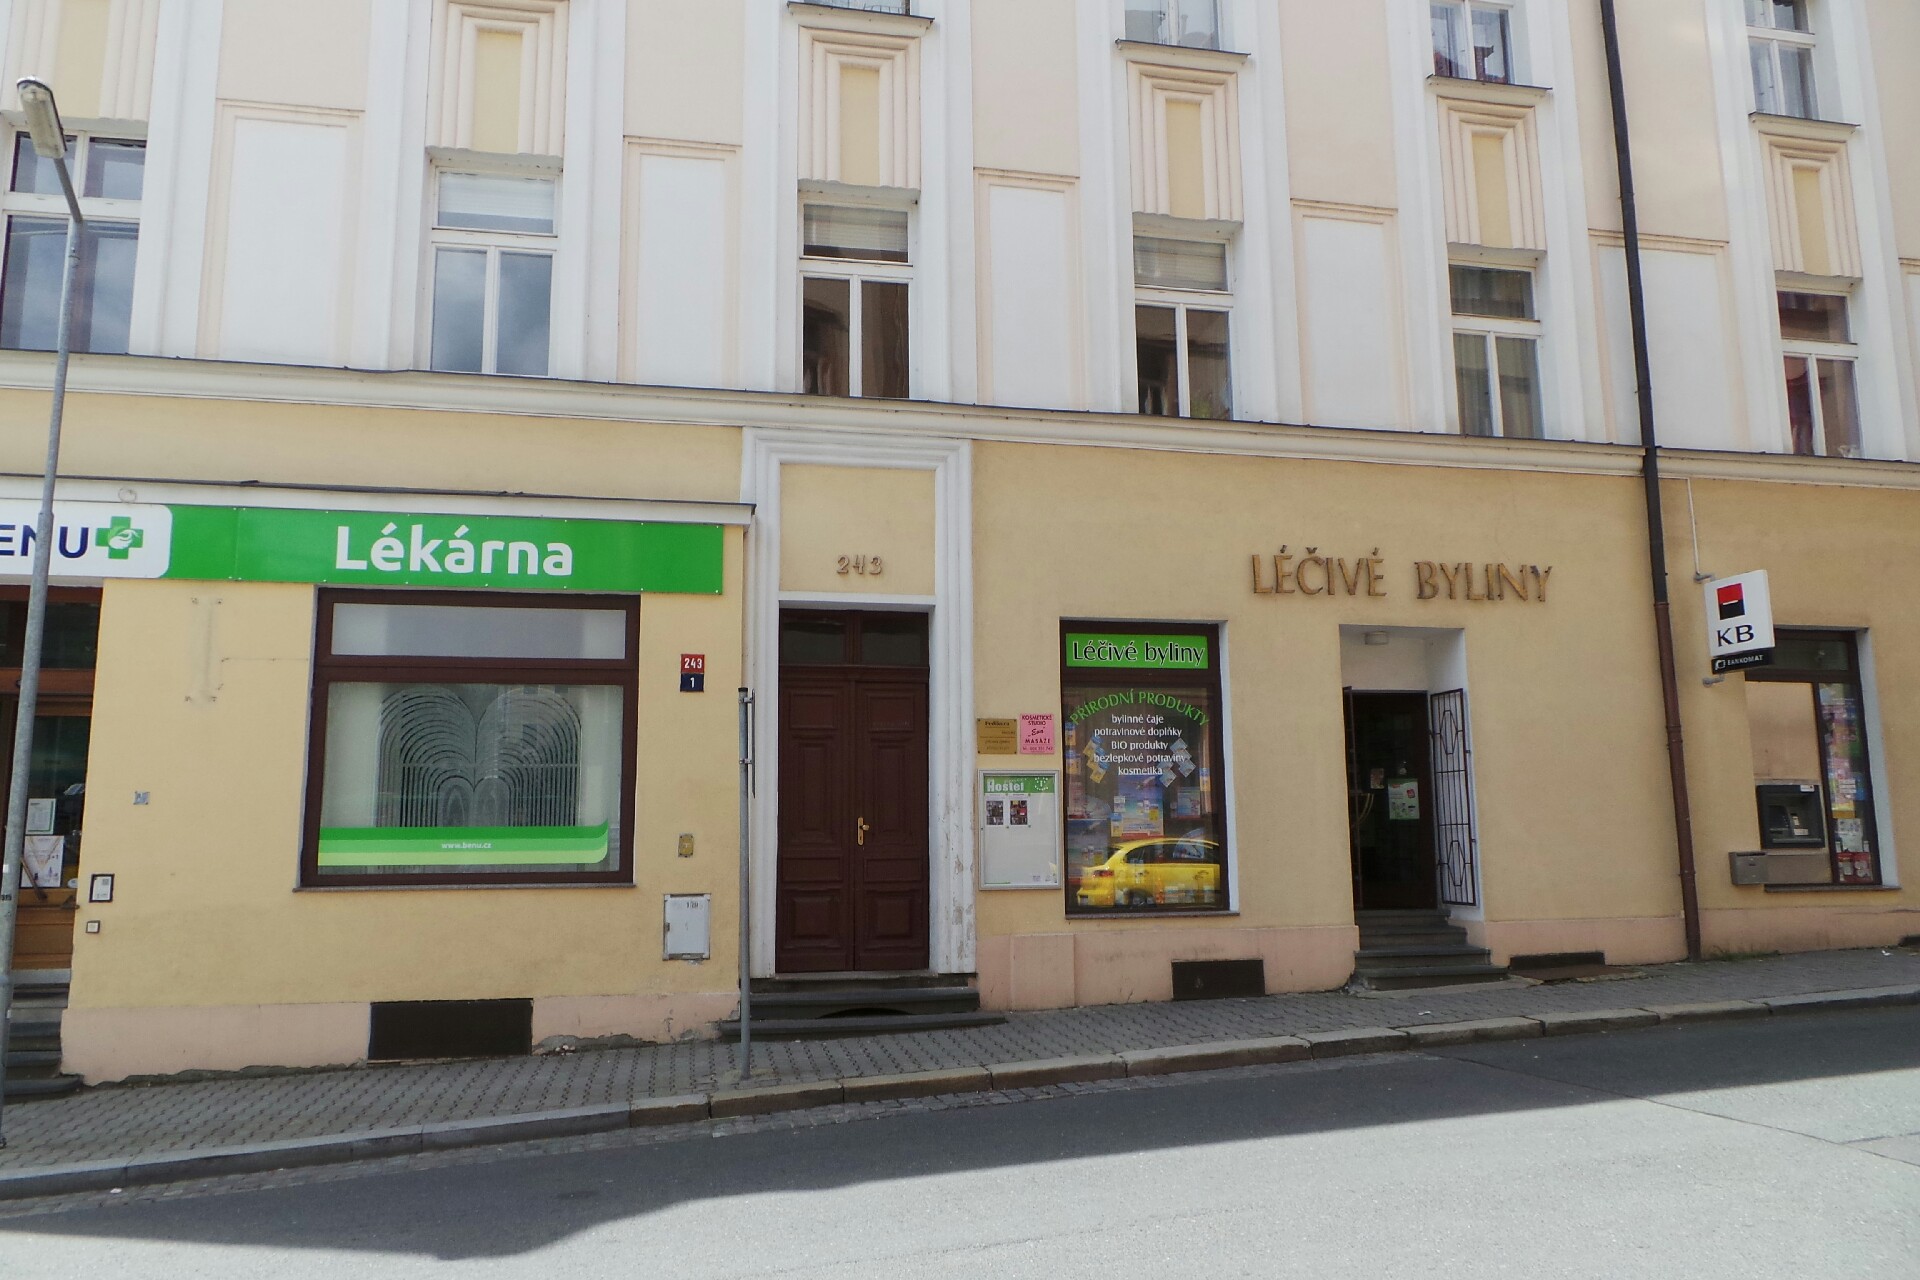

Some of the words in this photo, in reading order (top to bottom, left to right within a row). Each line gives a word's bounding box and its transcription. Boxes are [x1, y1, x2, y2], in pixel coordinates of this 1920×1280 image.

[336, 522, 573, 576] Lékárna
[837, 555, 882, 575] 243
[1252, 545, 1387, 597] LÉČIVÉ
[1414, 561, 1553, 602] BYLINY
[1717, 624, 1754, 648] KB
[1073, 640, 1137, 661] Léčivé
[1144, 642, 1205, 666] byliny
[684, 657, 702, 669] 243
[1727, 655, 1764, 666] BANKOMAT
[690, 677, 695, 688] 1
[1070, 688, 1134, 725] PŘÍRODNÍ
[1138, 691, 1210, 726] PRODUKTY
[1111, 714, 1144, 724] bylinné
[1146, 714, 1164, 724] čaje
[1094, 726, 1145, 737] potravinové
[1148, 727, 1182, 737] doplňky
[1111, 741, 1127, 750] BIO
[1130, 741, 1168, 751] produkty
[1094, 753, 1144, 764] bezlepkové
[1146, 754, 1187, 764] potraviny
[1118, 766, 1163, 776] kosmetika
[987, 779, 1024, 791] Hostel
